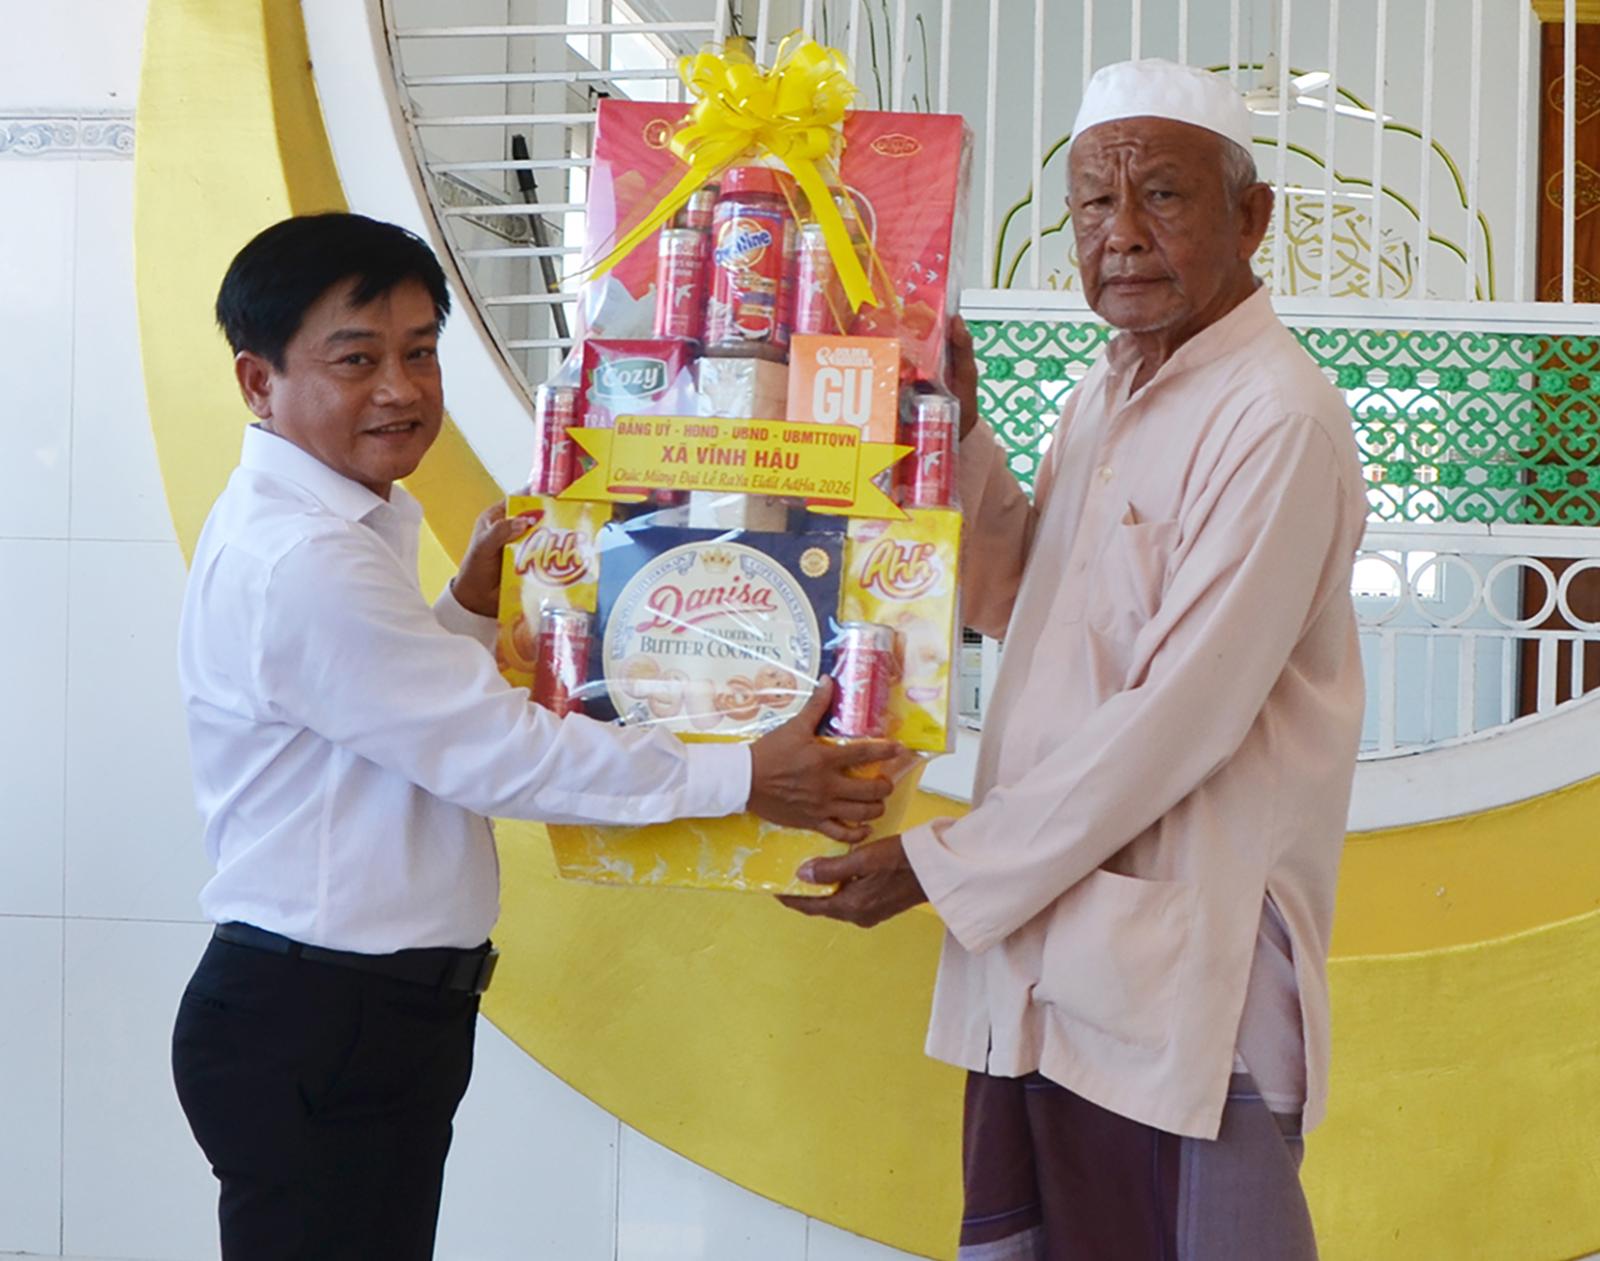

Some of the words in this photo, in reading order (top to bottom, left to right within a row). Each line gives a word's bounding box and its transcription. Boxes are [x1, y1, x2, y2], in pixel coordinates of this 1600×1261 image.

[602, 365, 658, 389] Cozy
[813, 367, 873, 424] GU
[731, 427, 769, 441] UBND
[783, 429, 857, 447] UBMTTQVN
[661, 442, 689, 463] XÃ
[696, 444, 747, 466] VĨNH
[754, 447, 800, 473] HẬU
[818, 480, 852, 495] 2026
[635, 575, 778, 634] Danisa
[640, 635, 704, 656] BUTTER
